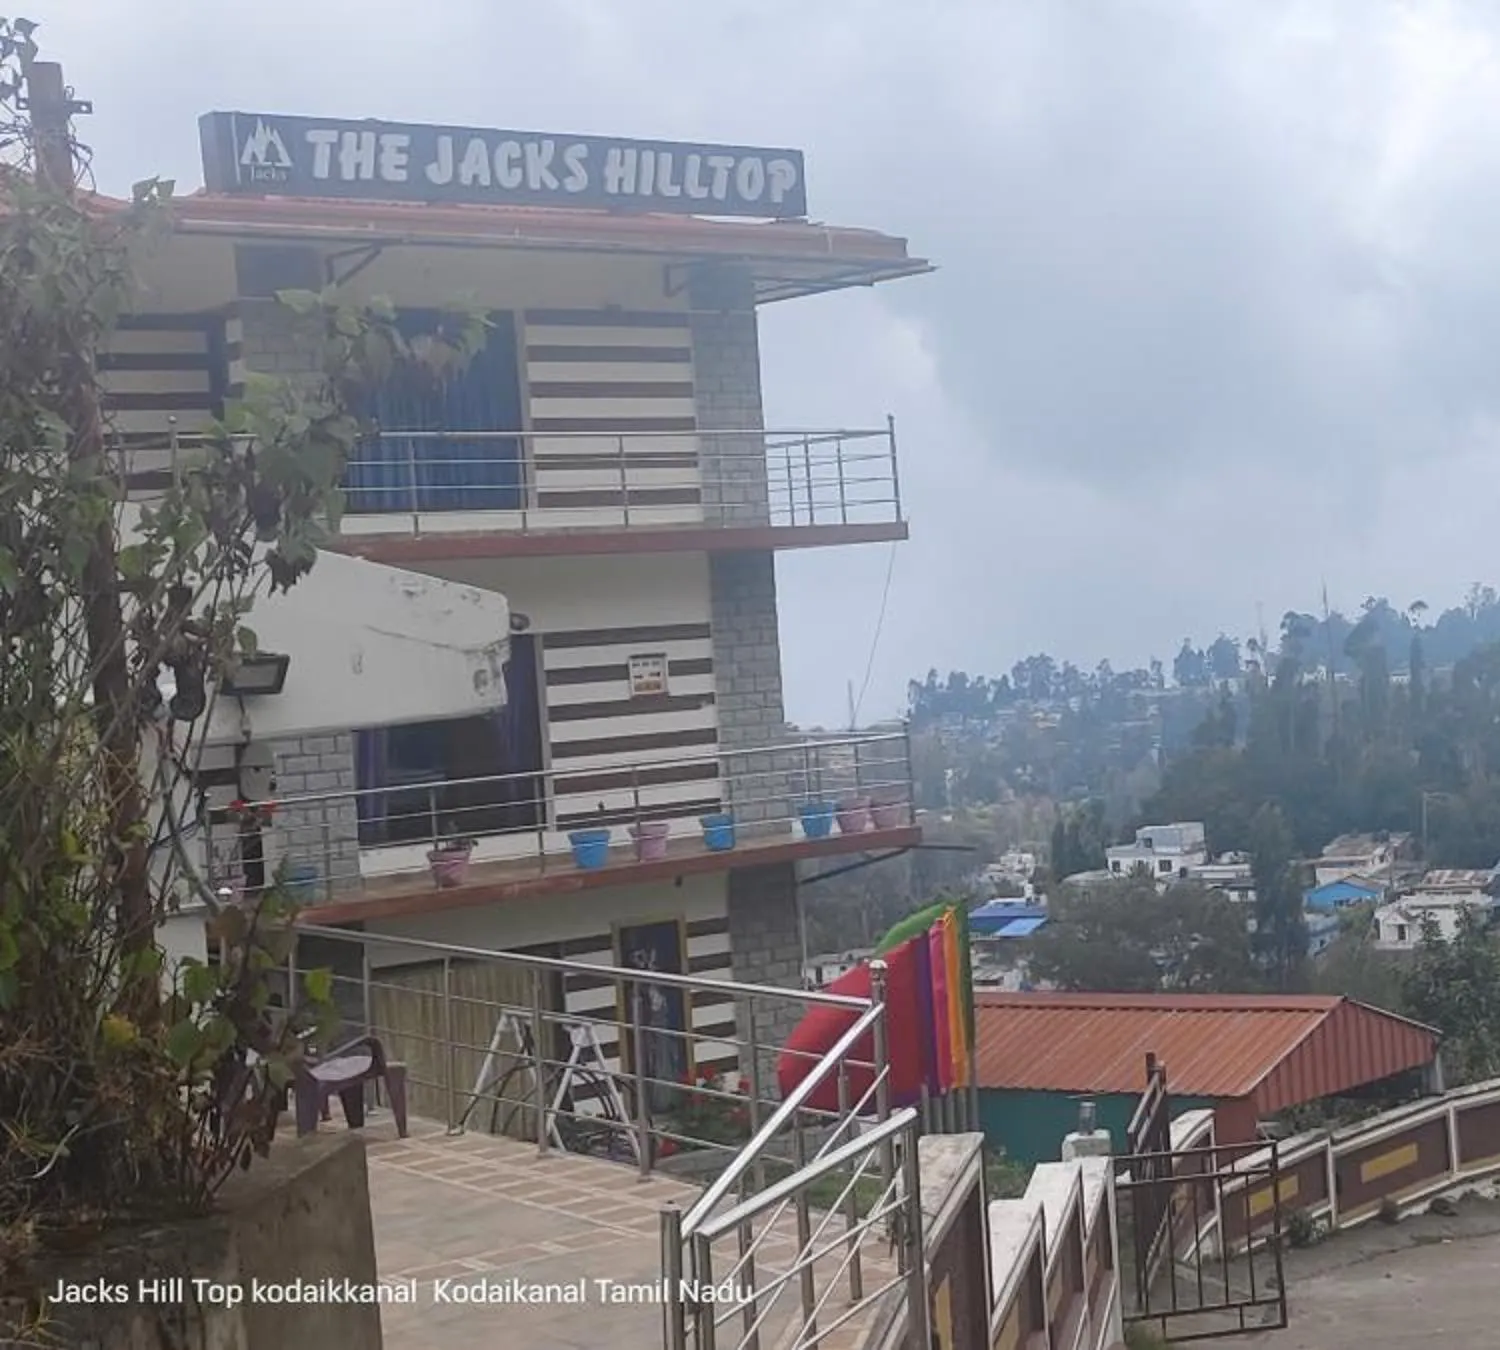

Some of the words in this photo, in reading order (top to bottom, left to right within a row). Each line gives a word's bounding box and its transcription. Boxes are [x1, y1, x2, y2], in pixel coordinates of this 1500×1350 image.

[305, 129, 410, 182] THE
[424, 135, 591, 194] JACKS
[603, 147, 799, 203] HILLTOP
